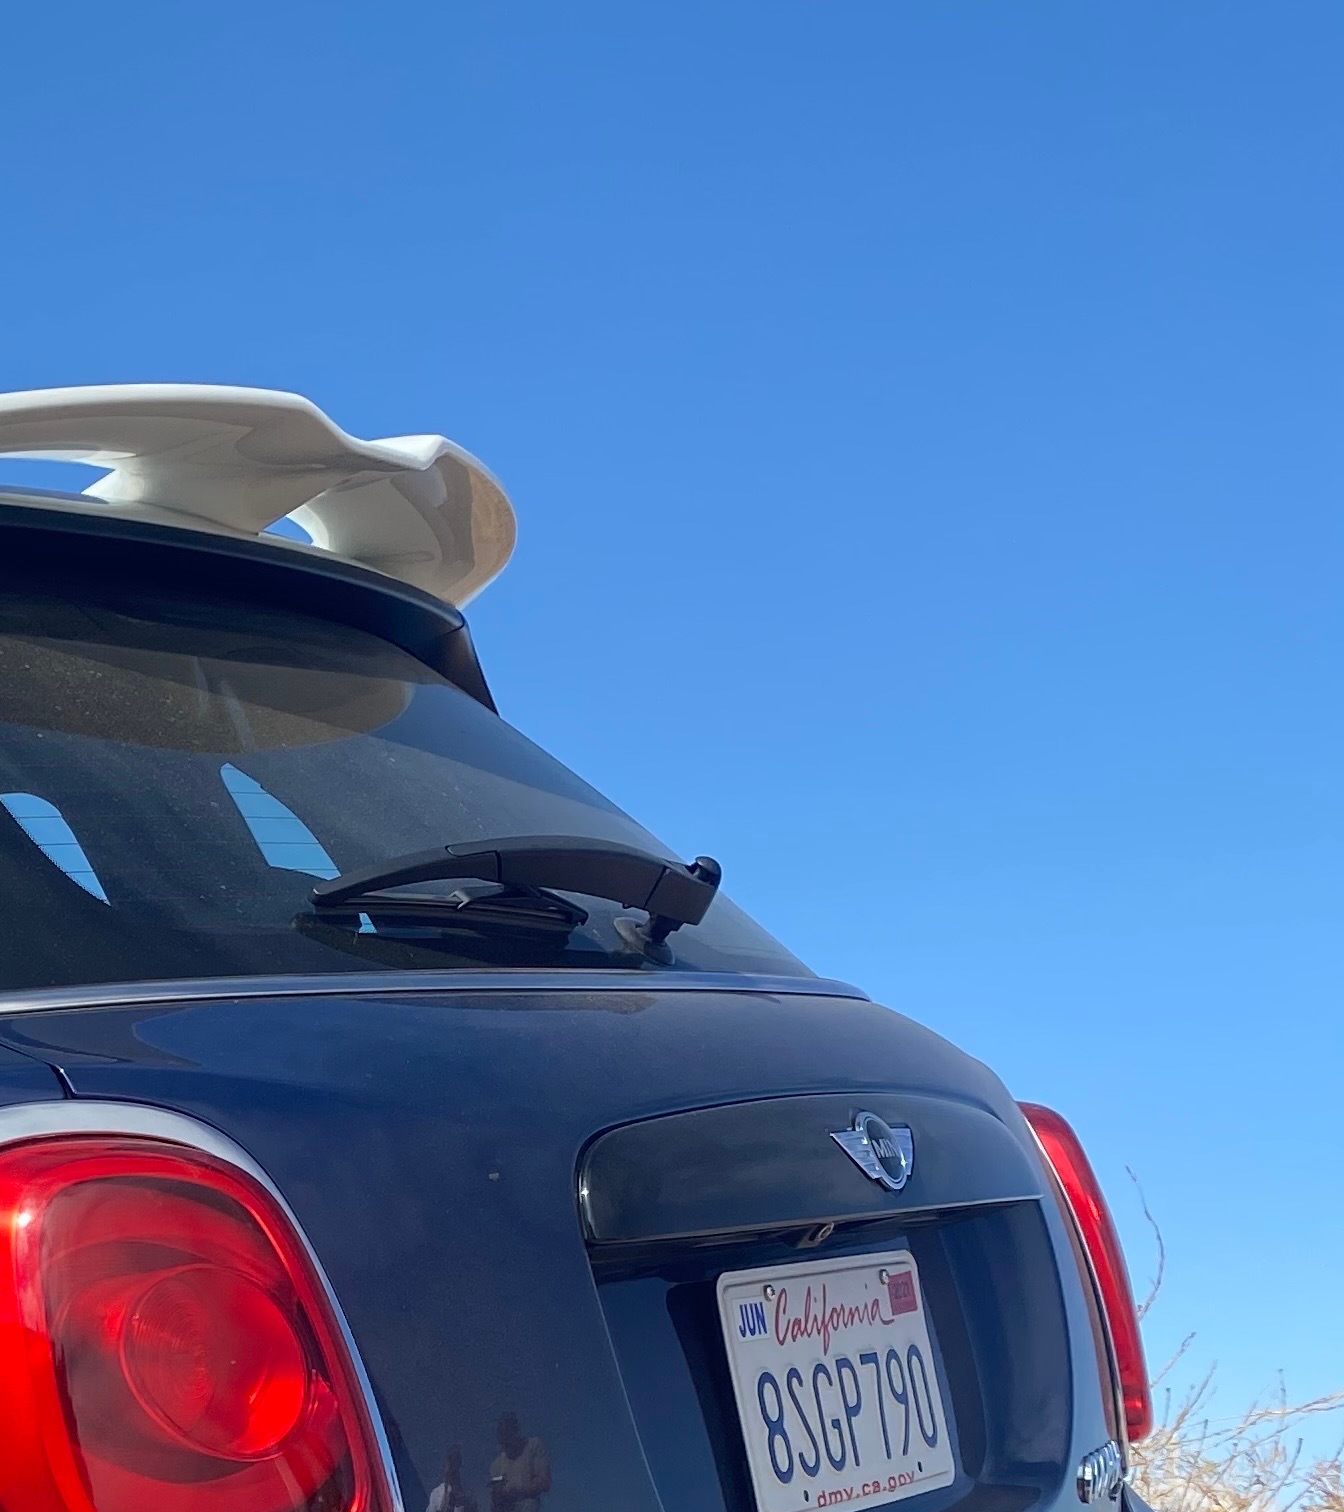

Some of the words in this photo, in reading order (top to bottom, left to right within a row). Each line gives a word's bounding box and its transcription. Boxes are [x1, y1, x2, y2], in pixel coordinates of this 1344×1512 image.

[738, 1301, 768, 1338] JUN
[774, 1283, 895, 1356] California
[757, 1344, 938, 1484] 8SGP790
[816, 1470, 916, 1508] dmv.ca.gov
